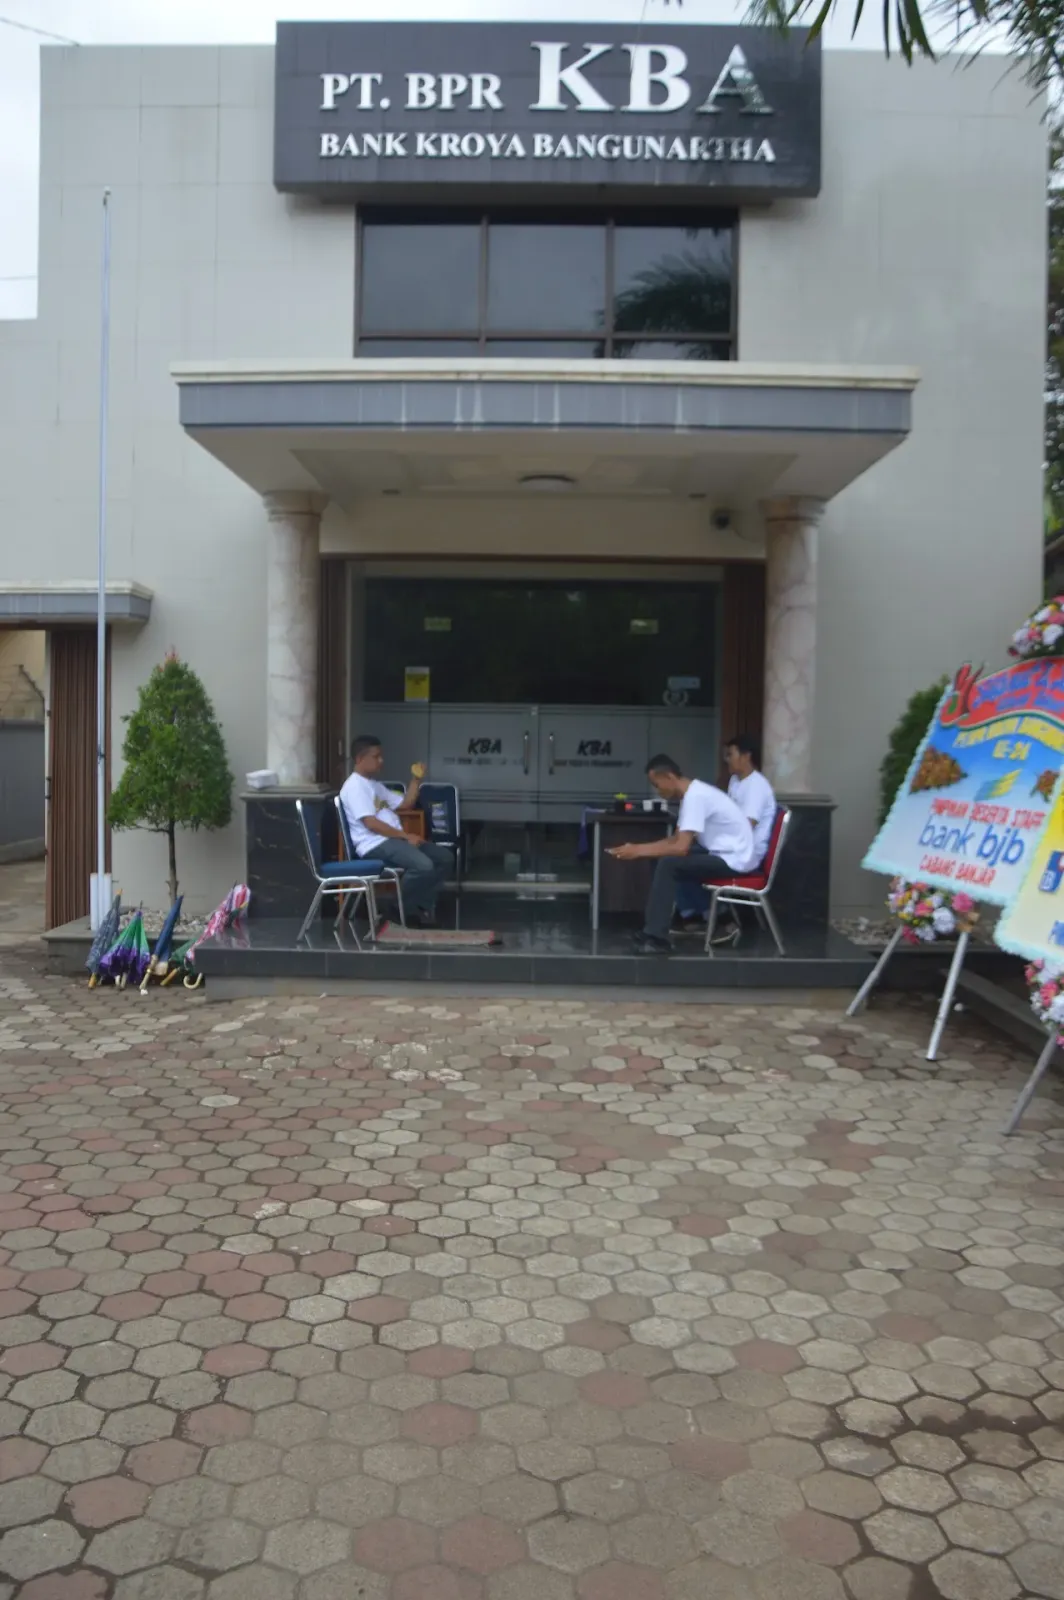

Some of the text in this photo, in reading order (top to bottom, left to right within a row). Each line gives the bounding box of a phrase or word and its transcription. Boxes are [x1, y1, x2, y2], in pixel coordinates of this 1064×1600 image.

[320, 42, 775, 114] PT. BPR KBA
[320, 133, 777, 163] BANK KROYA BANGUNARTHA
[468, 738, 502, 755] KBA
[577, 740, 612, 756] KBA
[918, 815, 1025, 867] bank bjb
